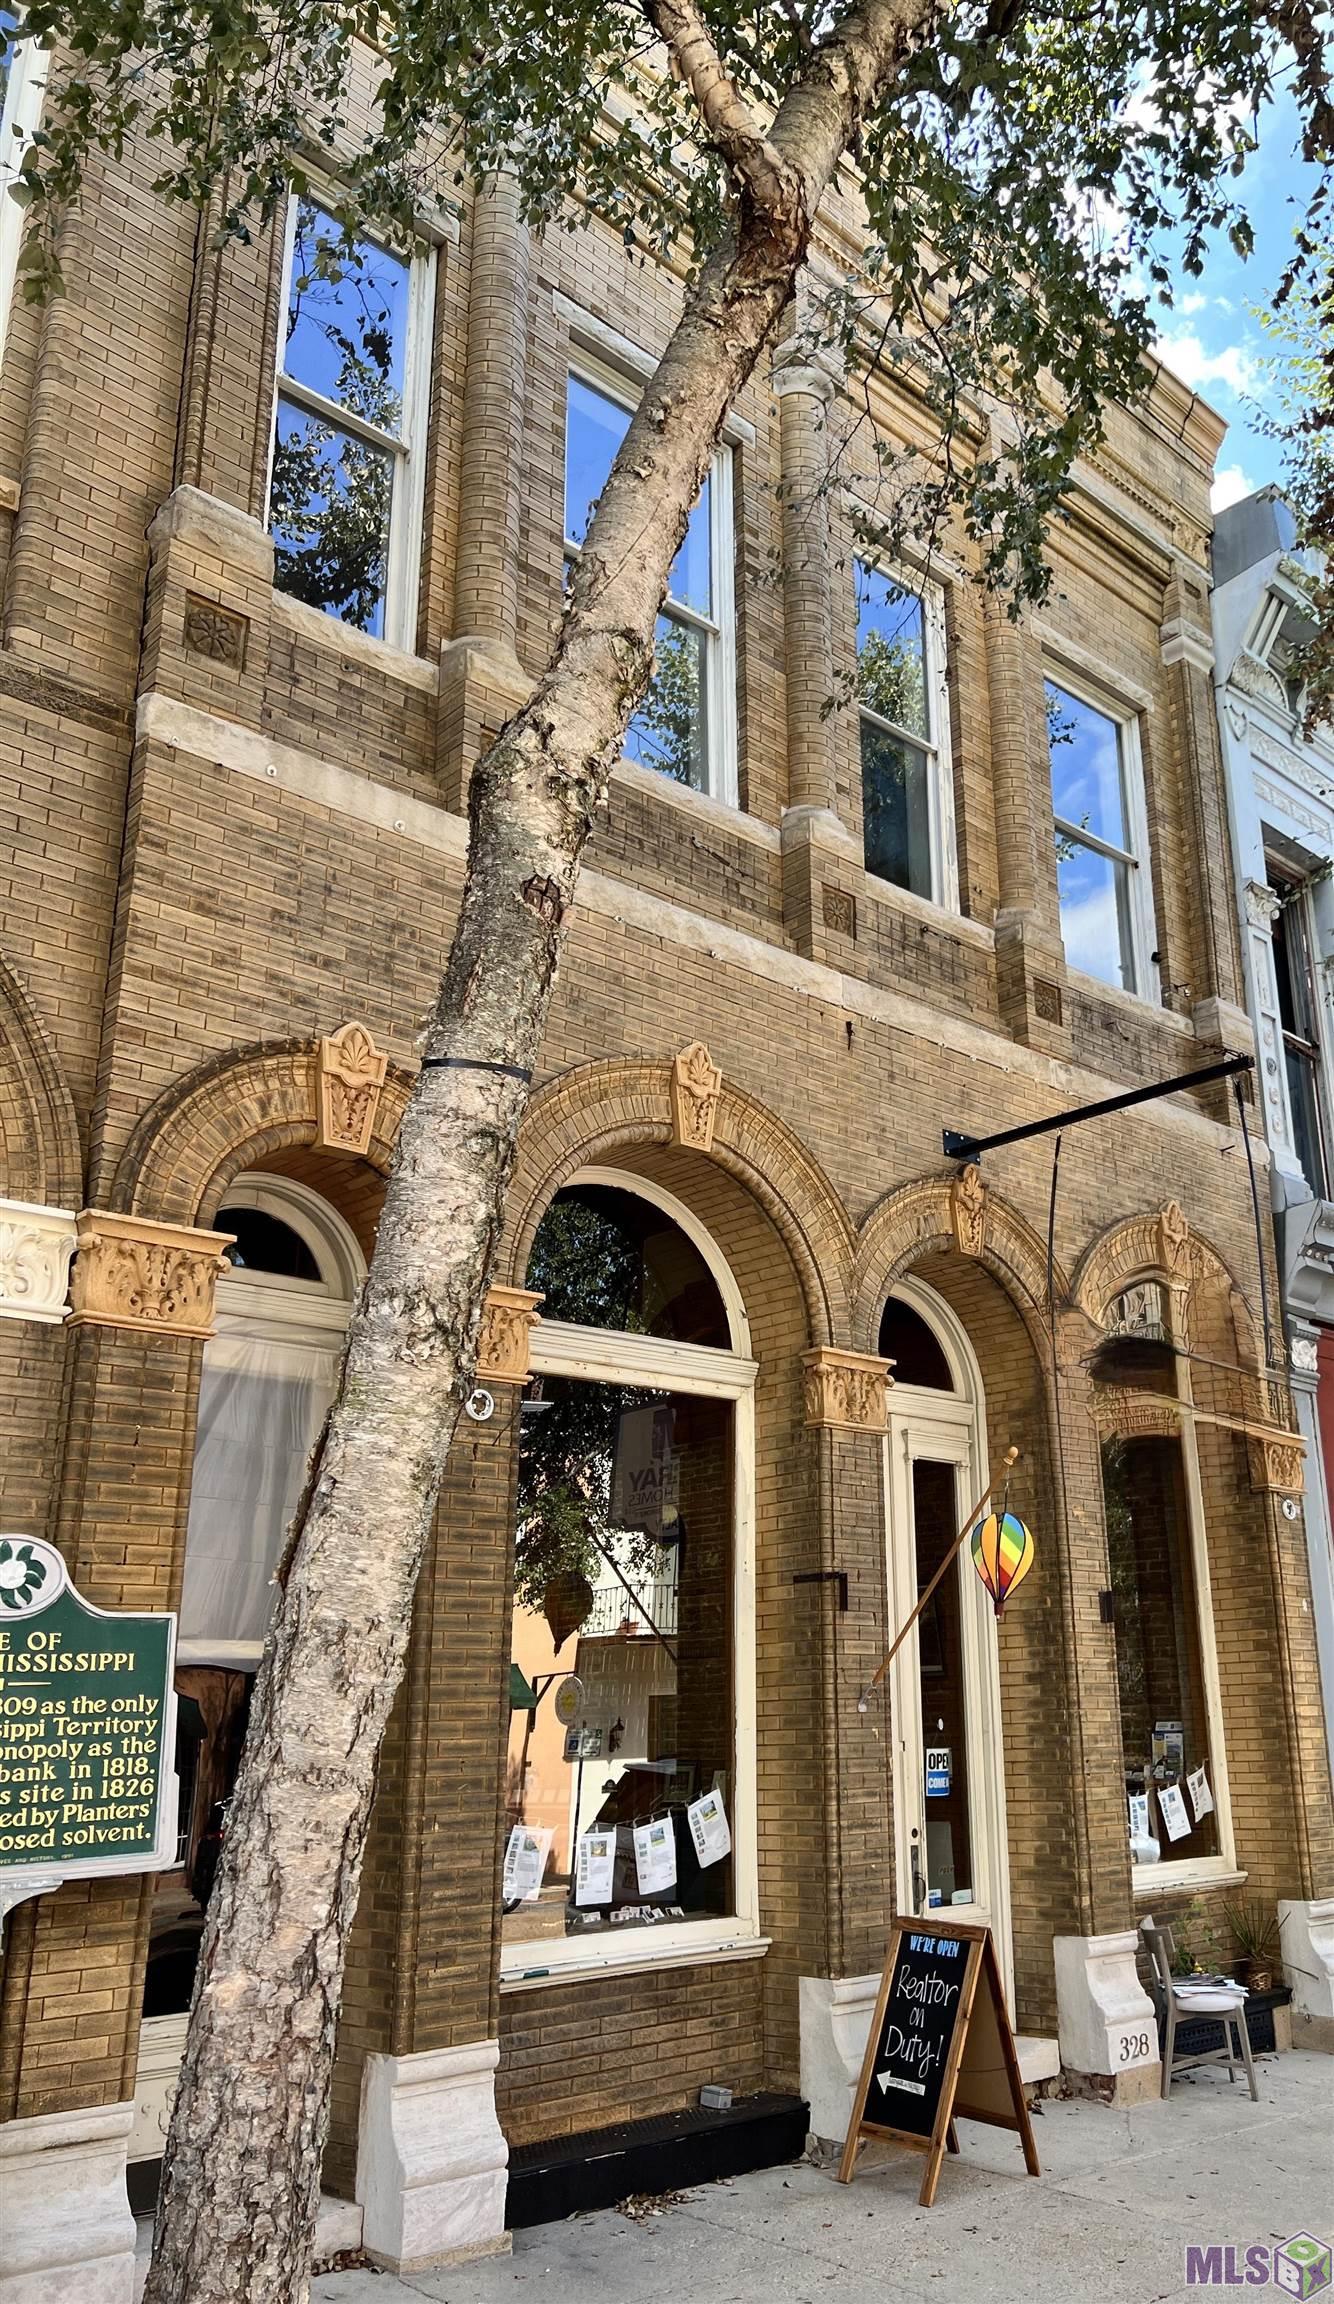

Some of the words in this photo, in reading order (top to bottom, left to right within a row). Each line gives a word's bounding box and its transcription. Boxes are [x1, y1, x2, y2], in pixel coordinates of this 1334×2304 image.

[27, 1631, 62, 1651] OF
[0, 1653, 135, 1673] ISSISSIPPI
[0, 1696, 37, 1716] 09
[41, 1700, 66, 1715] as
[72, 1695, 107, 1715] the
[111, 1694, 159, 1715] only
[0, 1719, 45, 1742] ippi
[53, 1716, 158, 1736] Territory
[0, 1739, 83, 1763] nopoly
[88, 1741, 113, 1757] as
[121, 1736, 157, 1754] the
[928, 1753, 949, 1770] OPE
[0, 1761, 57, 1783] bank
[69, 1761, 91, 1779] in
[102, 1757, 155, 1777] 1818.
[19, 1784, 64, 1804] site
[72, 1782, 93, 1801] in
[100, 1778, 155, 1799] 1826
[0, 1807, 27, 1828] ed
[30, 1807, 60, 1828] by
[61, 1798, 153, 1824] Planters'
[0, 1828, 55, 1851] osed
[62, 1821, 151, 1846] solvent.
[910, 1935, 936, 1954] WE'RE
[937, 1939, 960, 1957] OPEN
[896, 1964, 958, 2006] Realtor
[909, 2007, 924, 2028] on
[884, 2025, 944, 2078] Duty!
[1120, 2033, 1150, 2062] 328
